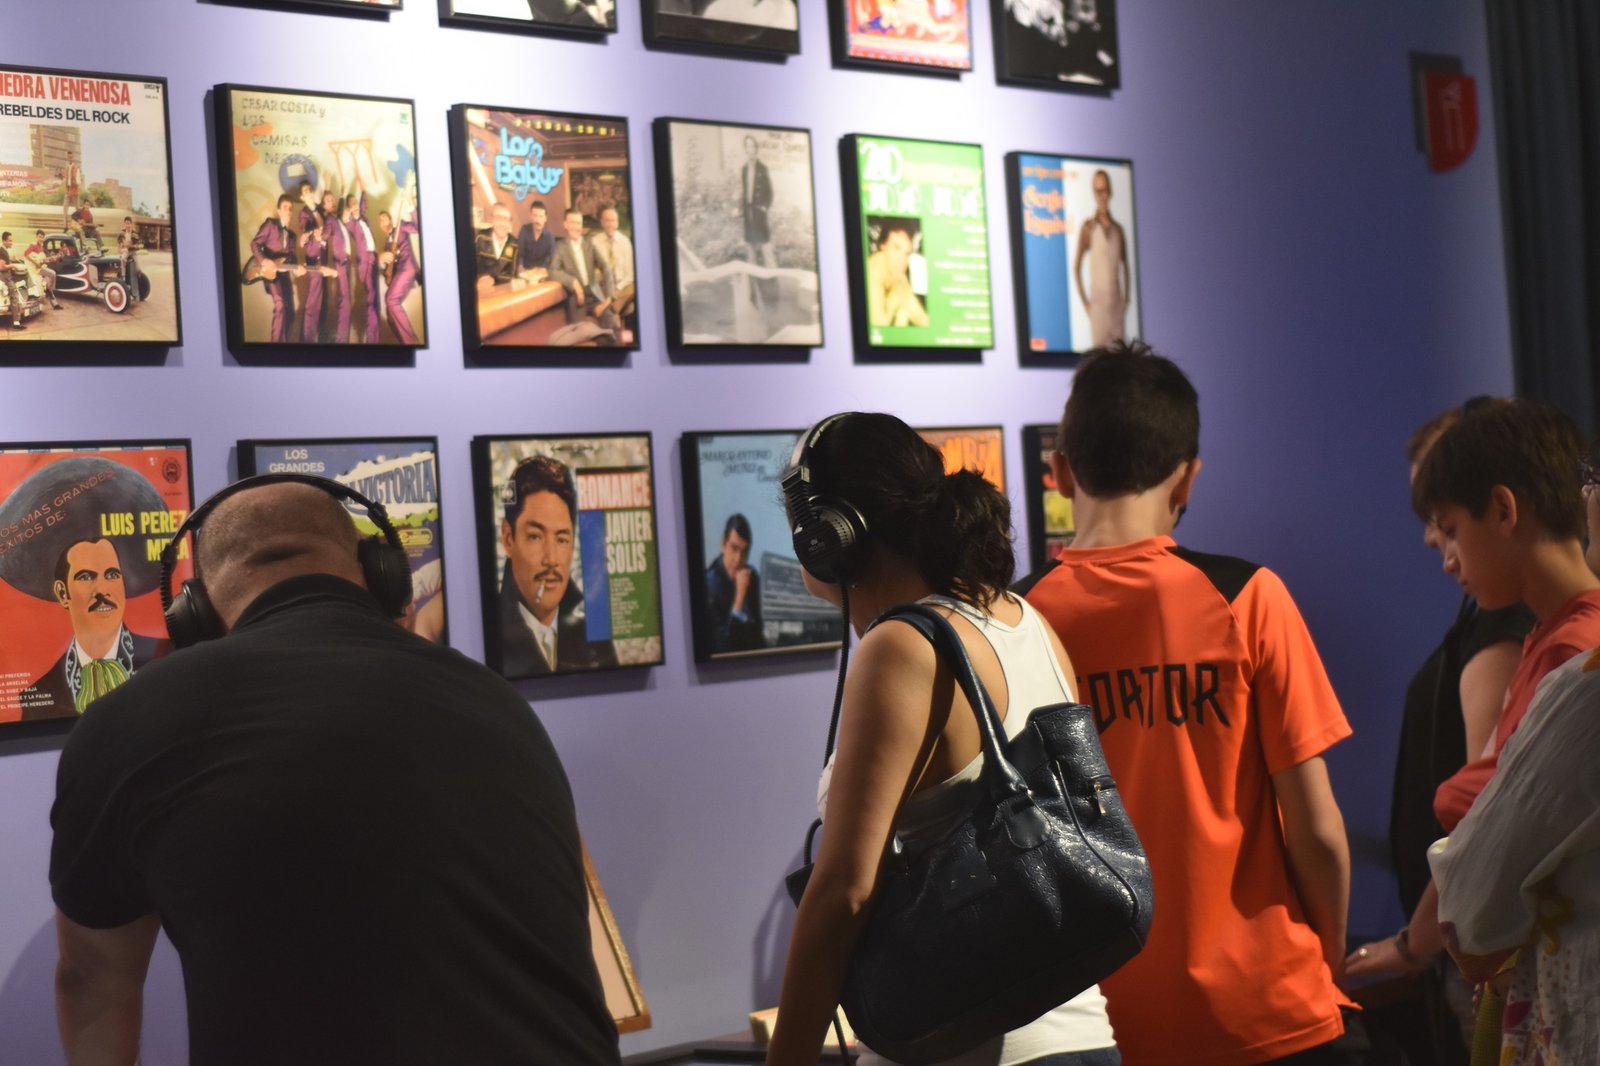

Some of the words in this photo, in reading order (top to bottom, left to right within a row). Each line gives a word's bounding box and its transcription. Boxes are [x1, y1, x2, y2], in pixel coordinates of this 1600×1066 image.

[49, 76, 131, 106] VENENOSA
[66, 108, 90, 122] DEL
[93, 110, 130, 124] ROCK
[280, 101, 317, 114] COSTA
[495, 153, 564, 201] Babys
[269, 462, 326, 473] GRANDES
[285, 449, 309, 461] LOS
[22, 503, 51, 526] MAS
[54, 465, 116, 508] GRANDES
[358, 458, 438, 504] VICTORIA
[577, 473, 651, 509] ROMANCE
[101, 512, 135, 537] LUIS
[605, 511, 652, 543] JAVIER
[146, 537, 190, 562] MA
[606, 542, 647, 575] SOLIS
[1077, 662, 1231, 736] DATOR
